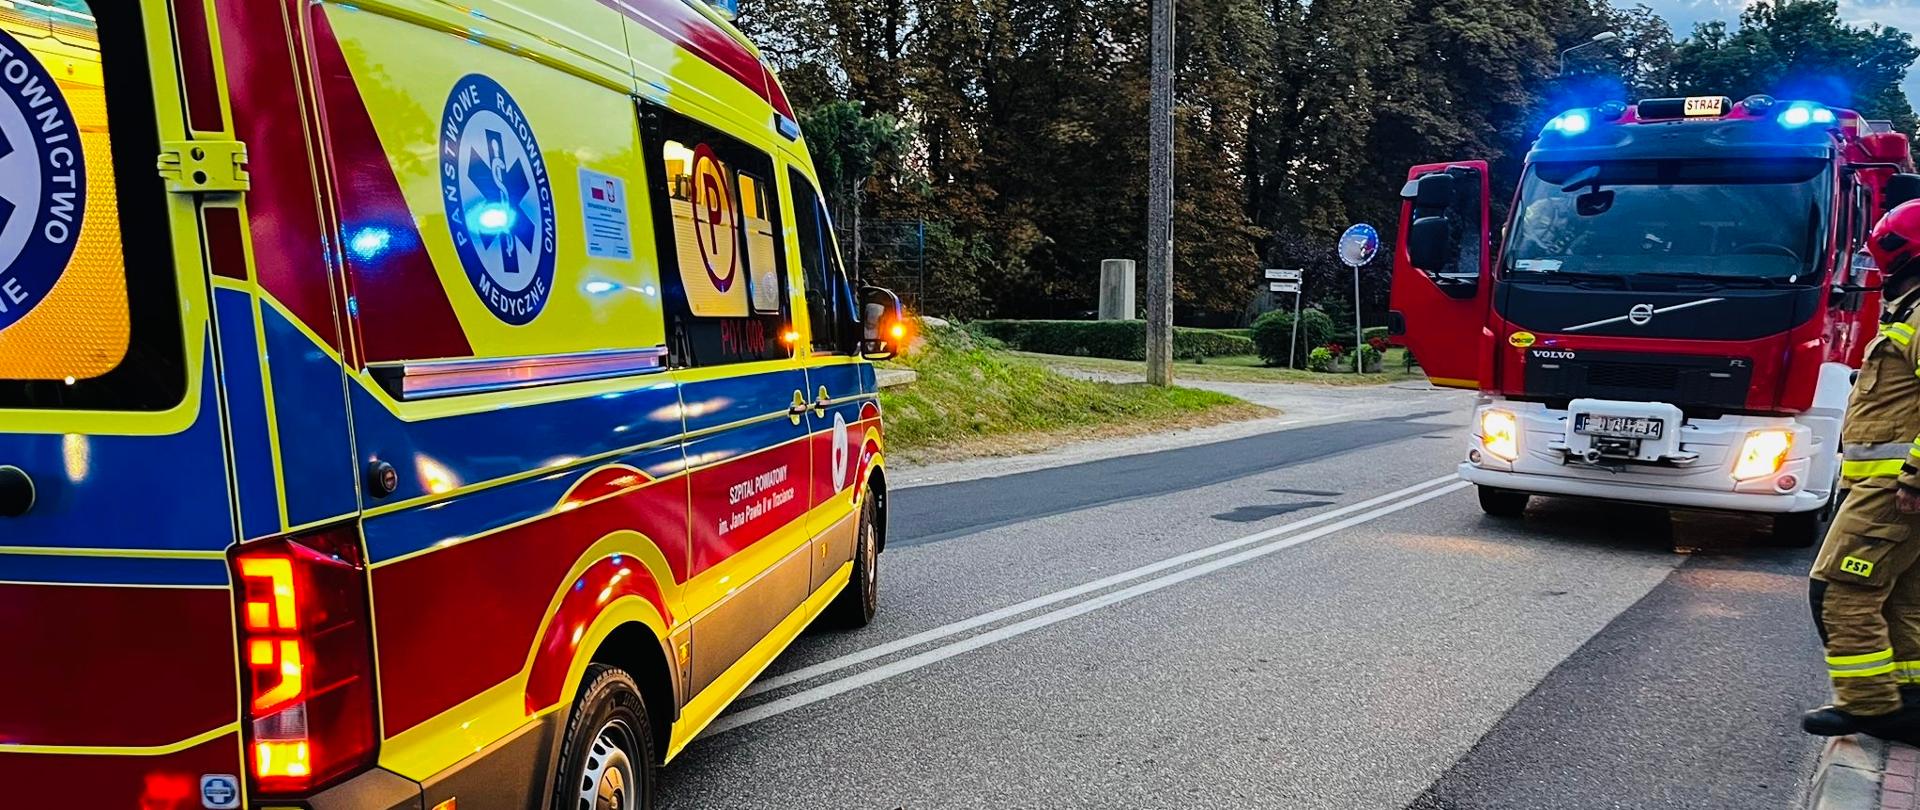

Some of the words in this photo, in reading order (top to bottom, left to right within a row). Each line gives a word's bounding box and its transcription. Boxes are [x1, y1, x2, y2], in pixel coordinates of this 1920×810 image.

[445, 84, 481, 246] PAŃSTWOWE
[496, 92, 553, 254] RATOWNICTWO
[703, 172, 723, 255] P
[479, 274, 546, 316] MEDYCZNE
[1533, 350, 1576, 360] VOLVO
[1729, 359, 1747, 368] FL
[729, 479, 755, 505] SZPITAL
[755, 464, 787, 493] POWIATOWY
[729, 512, 745, 530] Jana
[1846, 560, 1868, 572] PSP
